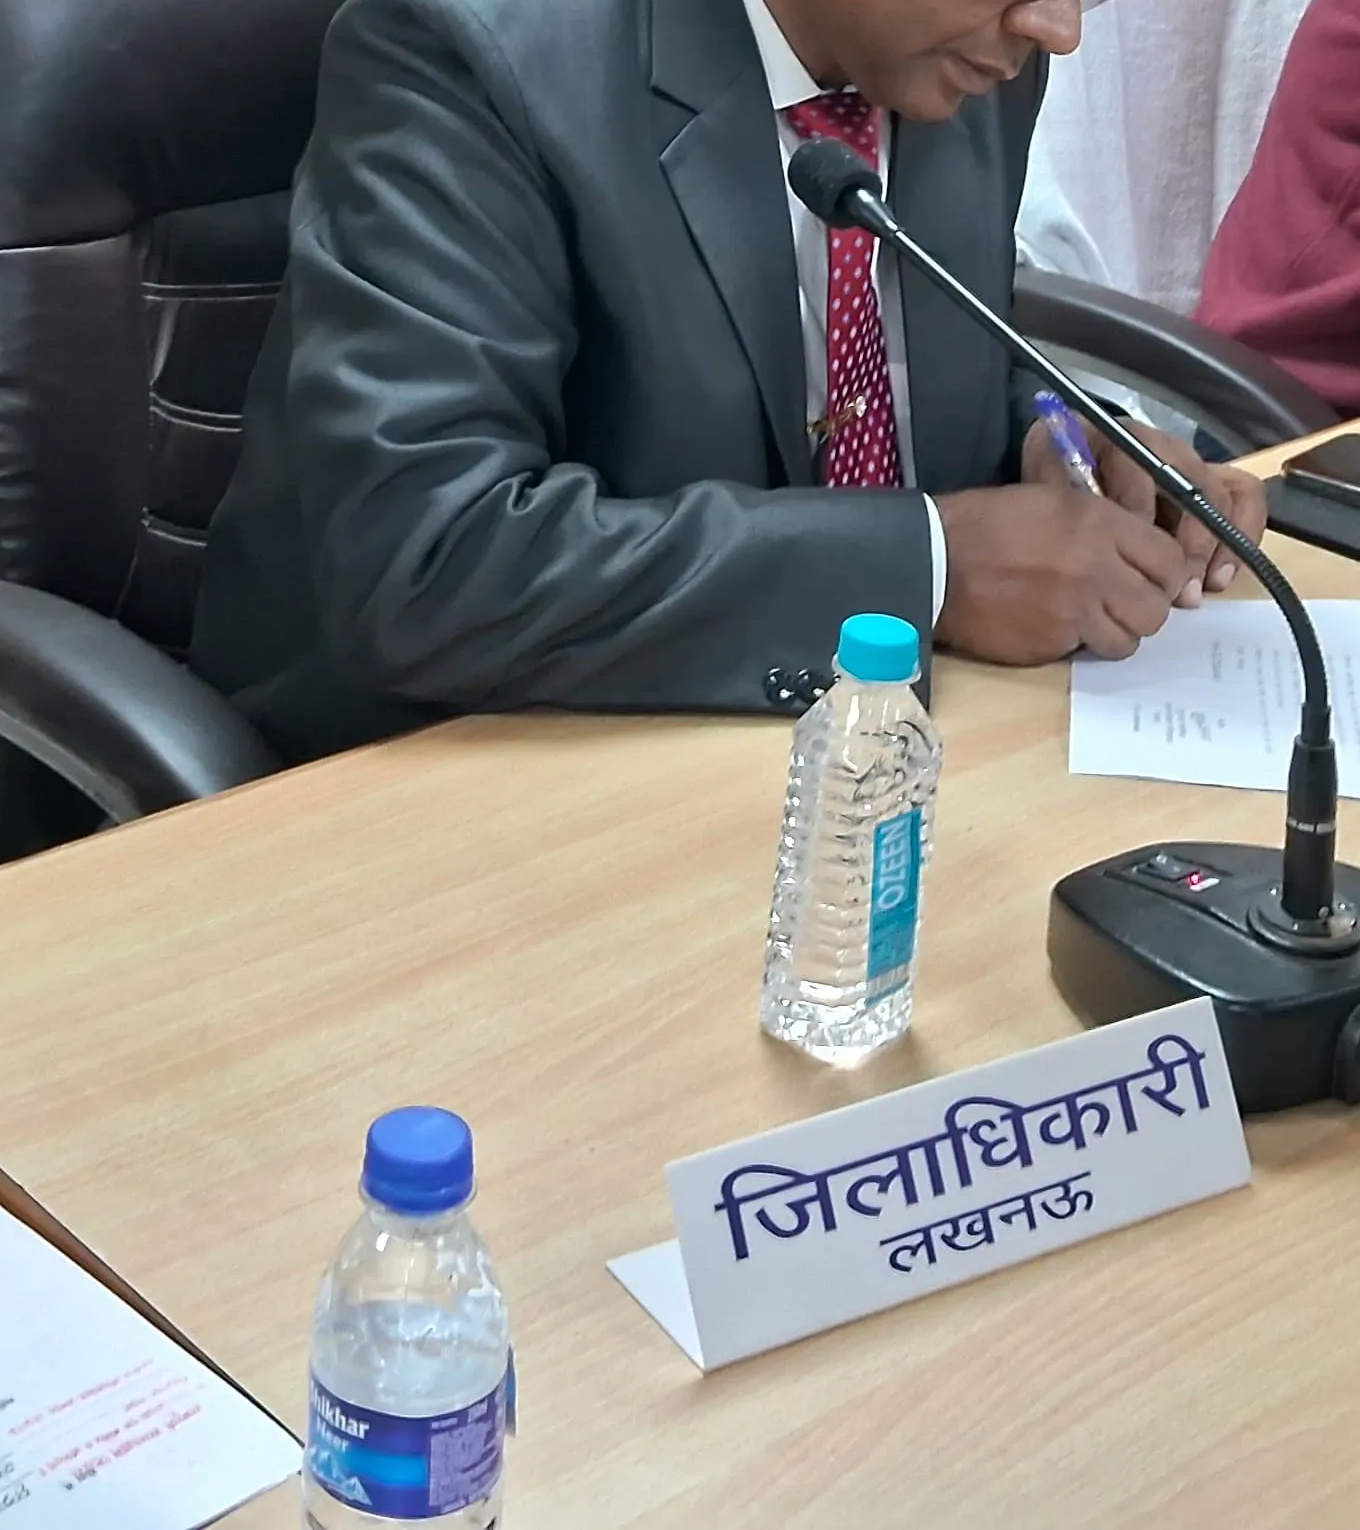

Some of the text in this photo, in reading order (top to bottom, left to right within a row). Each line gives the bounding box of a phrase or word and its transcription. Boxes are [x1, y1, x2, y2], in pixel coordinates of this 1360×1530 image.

[714, 1034, 1211, 1262] जिलाधिकारी
[880, 1170, 1095, 1273] लखनऊ
[311, 1380, 371, 1440] hikhar
